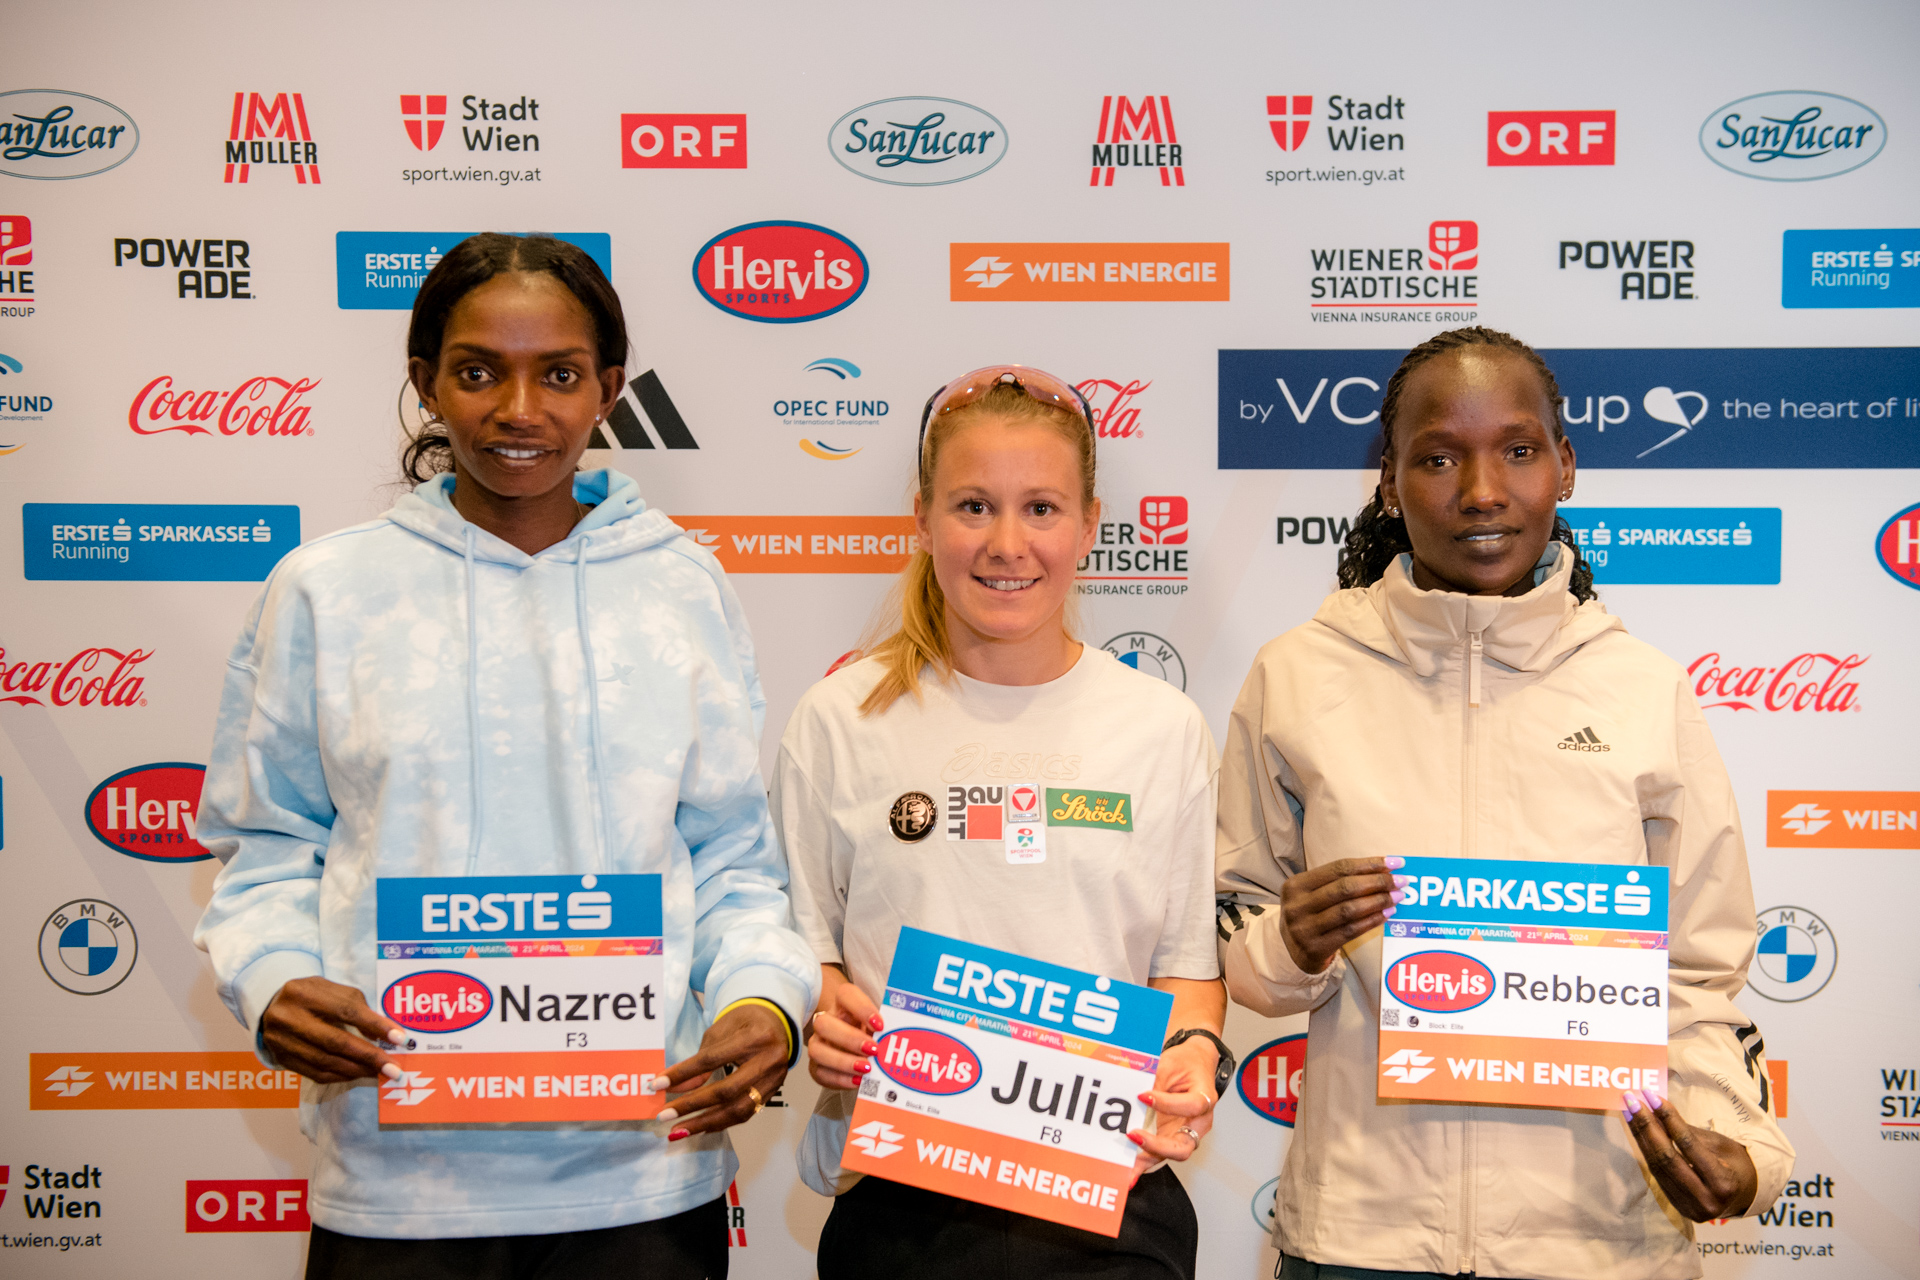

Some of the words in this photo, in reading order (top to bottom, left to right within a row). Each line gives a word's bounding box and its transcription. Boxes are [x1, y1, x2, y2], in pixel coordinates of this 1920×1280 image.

[461, 96, 540, 122] Stadt
[1327, 95, 1405, 121] Stadt
[462, 126, 540, 152] Wien
[631, 125, 738, 157] ORF
[845, 112, 994, 167] SanLucar
[1326, 126, 1404, 152] Wien
[1496, 121, 1607, 156] ORF
[1717, 106, 1873, 163] SanLucar
[402, 166, 542, 185] sport.wien.gv.at
[1266, 167, 1405, 186] sport.wien.gv.at
[114, 238, 250, 268] POWER
[365, 253, 422, 270] ERSTE
[1311, 249, 1423, 272] WIENER
[1559, 241, 1695, 270] POWER
[1811, 251, 1871, 268] ERSTE
[713, 246, 854, 300] Hervis
[1024, 262, 1096, 282] WIEN
[1104, 262, 1217, 282] ENERGIE
[1811, 269, 1890, 290] Running
[726, 293, 791, 304] SPORTS
[1311, 276, 1478, 298] STÄDTISCHE
[1311, 311, 1357, 323] VIENNA
[1361, 311, 1432, 323] INSURANCE
[1435, 311, 1478, 323] GROUP
[129, 375, 323, 437] Coca-Cola
[773, 400, 828, 416] OPEC
[836, 400, 889, 416] FUND
[1240, 400, 1274, 424] by
[1722, 399, 1771, 419] the
[1781, 398, 1859, 419] heart
[1867, 397, 1898, 419] of
[52, 525, 110, 542] ERSTE
[139, 525, 250, 543] SPARKASSE
[731, 535, 803, 555] WIEN
[1618, 528, 1730, 546] SPARKASSE
[52, 543, 130, 563] Running
[1147, 584, 1188, 595] GROUP
[1557, 741, 1611, 753] adidas
[1052, 792, 1127, 826] Ströck
[1843, 810, 1917, 831] WIEN
[119, 833, 184, 843] SPORTS
[1398, 875, 1609, 914] SPARKASSE
[52, 904, 125, 930] BMW
[421, 892, 560, 933] ERSTE
[1427, 926, 1457, 936] VIENNA
[1458, 928, 1476, 937] CITY
[1477, 929, 1522, 939] MARATHON
[1544, 932, 1567, 941] APRIL
[1569, 933, 1589, 941] 2024
[422, 945, 452, 955] VIENNA
[453, 945, 471, 954] CITY
[472, 945, 518, 954] MARATHON
[932, 953, 1071, 1024] ERSTE
[1397, 963, 1487, 1000] Hervis
[1503, 972, 1661, 1008] Rebbeca
[394, 985, 485, 1020] Hervis
[500, 984, 656, 1022] Nazret
[1405, 994, 1446, 1002] SPORTS
[926, 1003, 955, 1019] VIENNA
[956, 1010, 974, 1023] CITY
[974, 1014, 1019, 1035] MARATHON
[1038, 1032, 1061, 1047] APRIL
[1062, 1039, 1082, 1051] 2024
[1567, 1020, 1589, 1036] F6
[566, 1033, 588, 1048] F3
[884, 1034, 972, 1083] Hervis
[105, 1071, 178, 1091] WIEN
[186, 1070, 299, 1090] ENERGIE
[447, 1076, 525, 1099] WIEN
[534, 1073, 657, 1098] ENERGIE
[1446, 1057, 1525, 1083] WIEN
[1533, 1062, 1659, 1091] ENERGIE
[991, 1060, 1132, 1134] Julia
[1040, 1126, 1063, 1145] F8
[24, 1164, 102, 1190] Stadt
[916, 1138, 992, 1178] WIEN
[996, 1159, 1118, 1211] ENERGIE
[1779, 1173, 1835, 1198] adt
[24, 1194, 101, 1219] Wien
[195, 1190, 302, 1222] ORF
[0, 1232, 102, 1252] t.wien.gv.at
